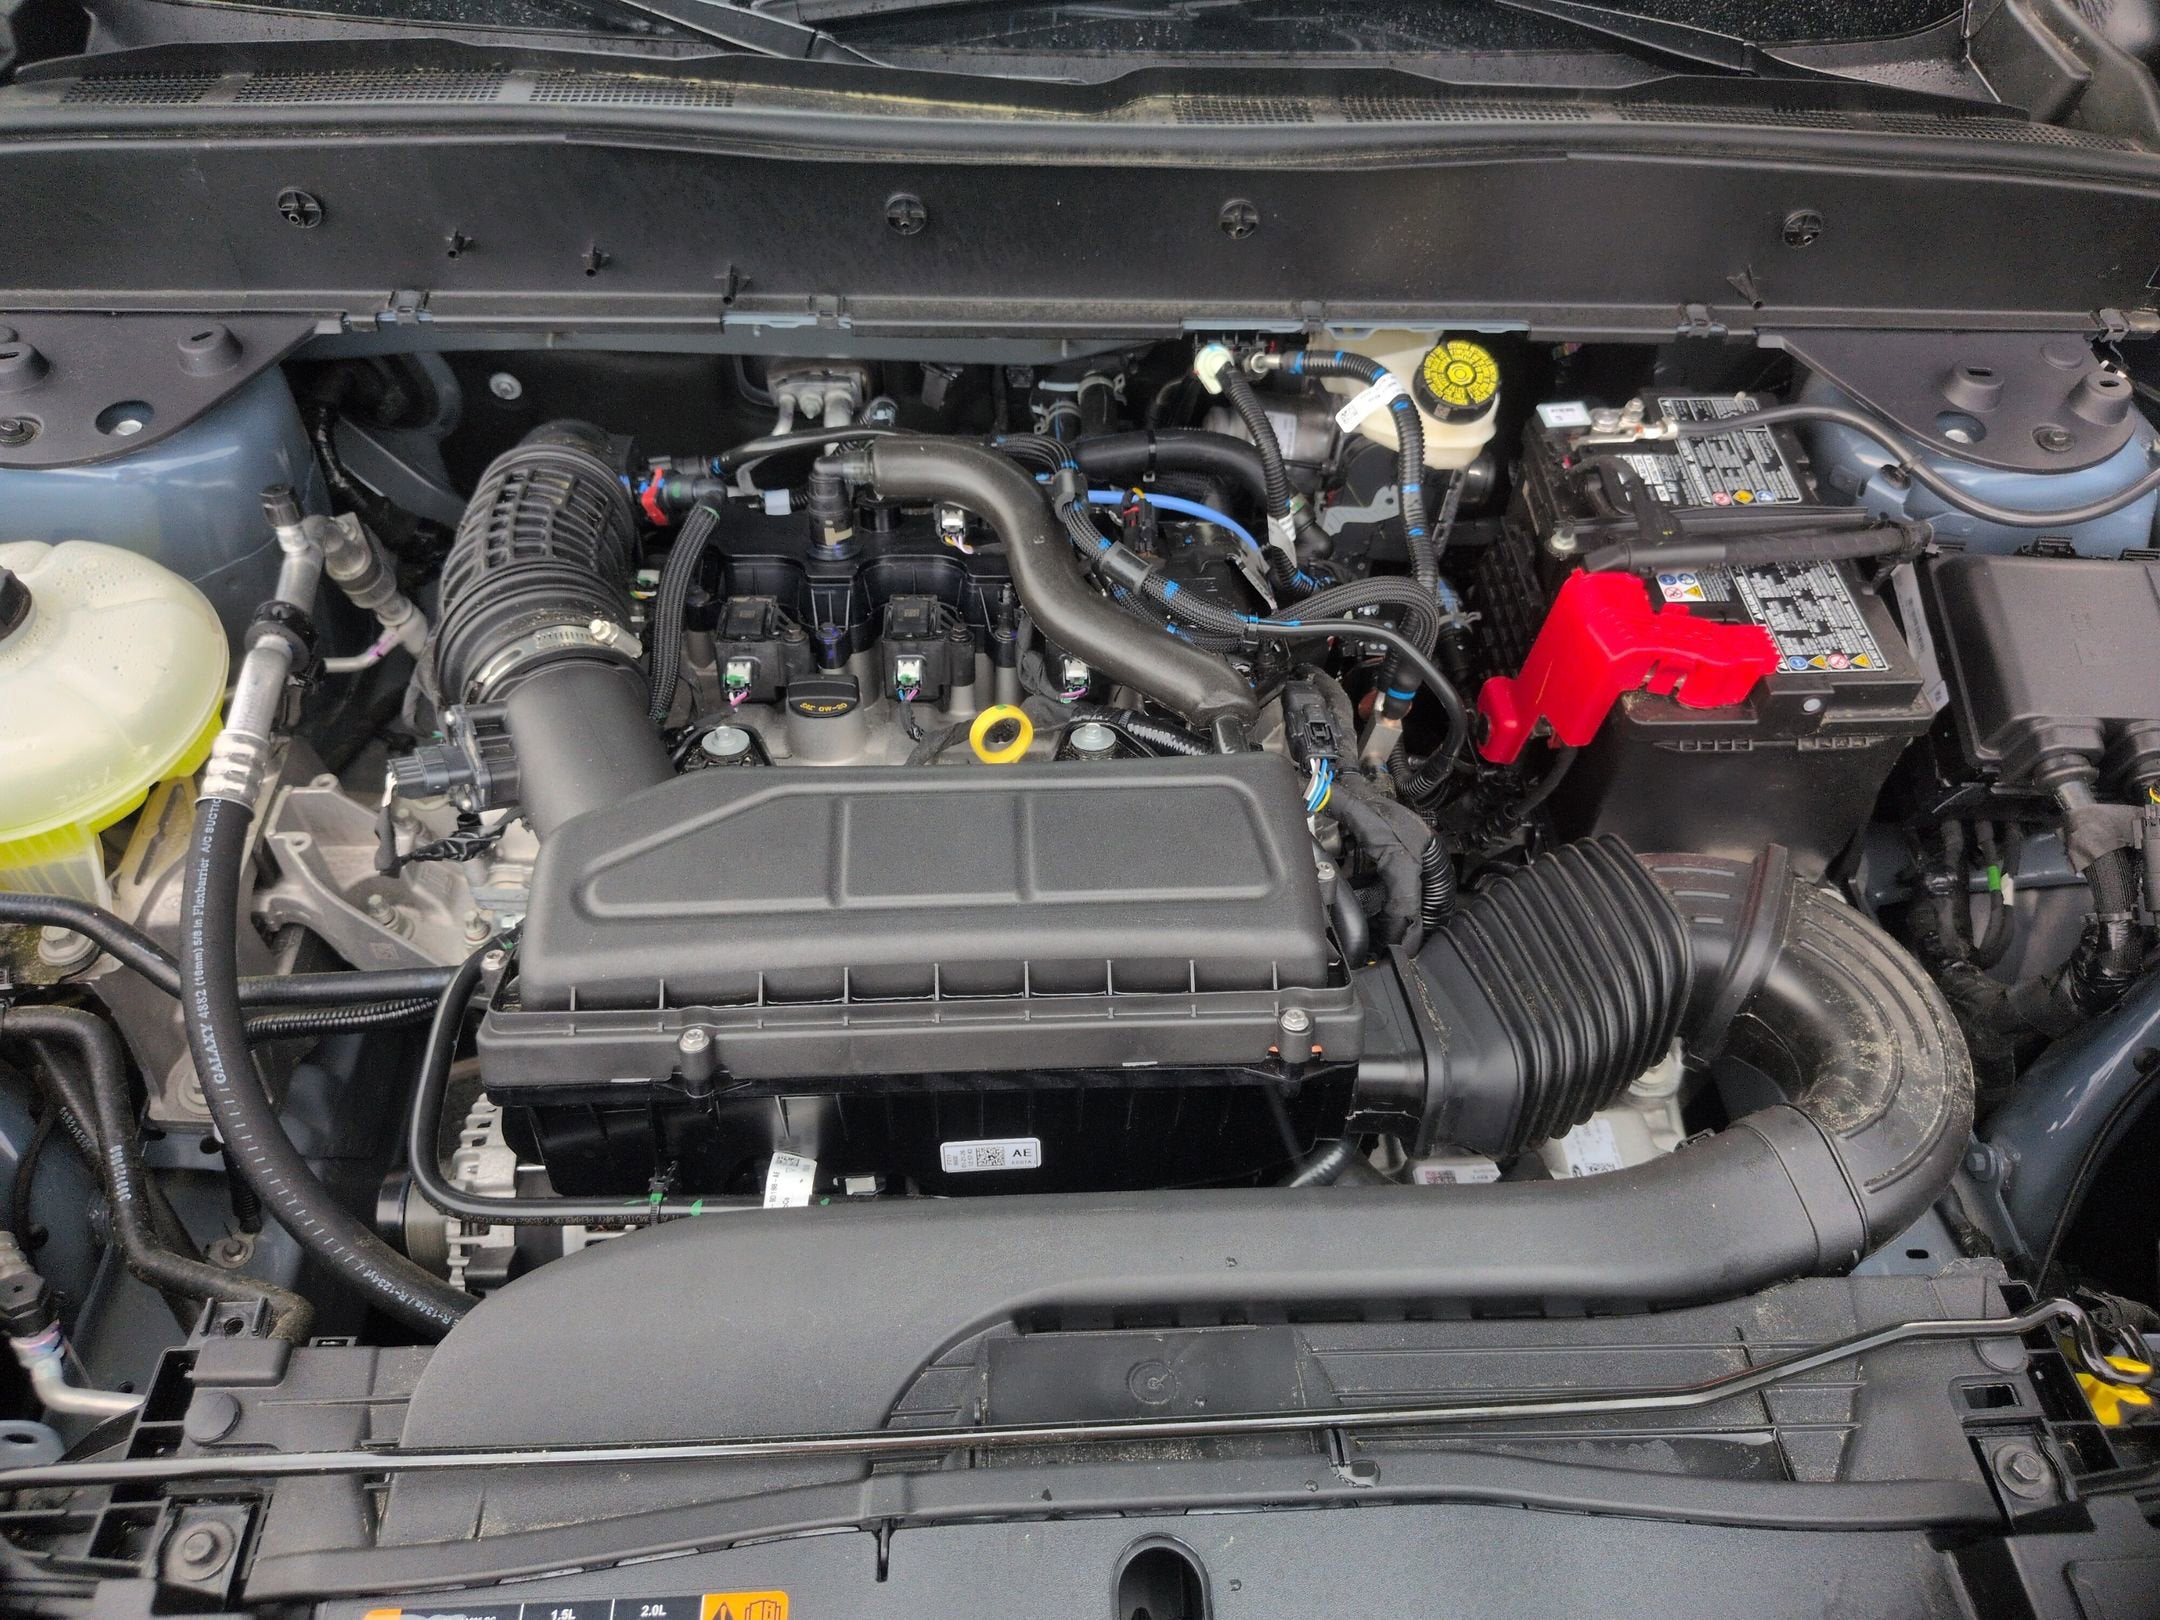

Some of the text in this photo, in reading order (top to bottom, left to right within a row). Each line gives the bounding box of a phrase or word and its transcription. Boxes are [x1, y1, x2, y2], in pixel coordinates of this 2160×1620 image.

[201, 836, 213, 853] A/C
[192, 858, 209, 916] Flexbarrier
[192, 930, 203, 946] 5/8
[193, 948, 206, 986] (16mm)
[195, 988, 210, 1019] 4882
[200, 1022, 227, 1084] GALAXY
[1012, 1148, 1033, 1157] AE
[415, 1300, 452, 1325] R-134a
[551, 1608, 576, 1620] 1.5L
[640, 1604, 667, 1617] 2.0L
